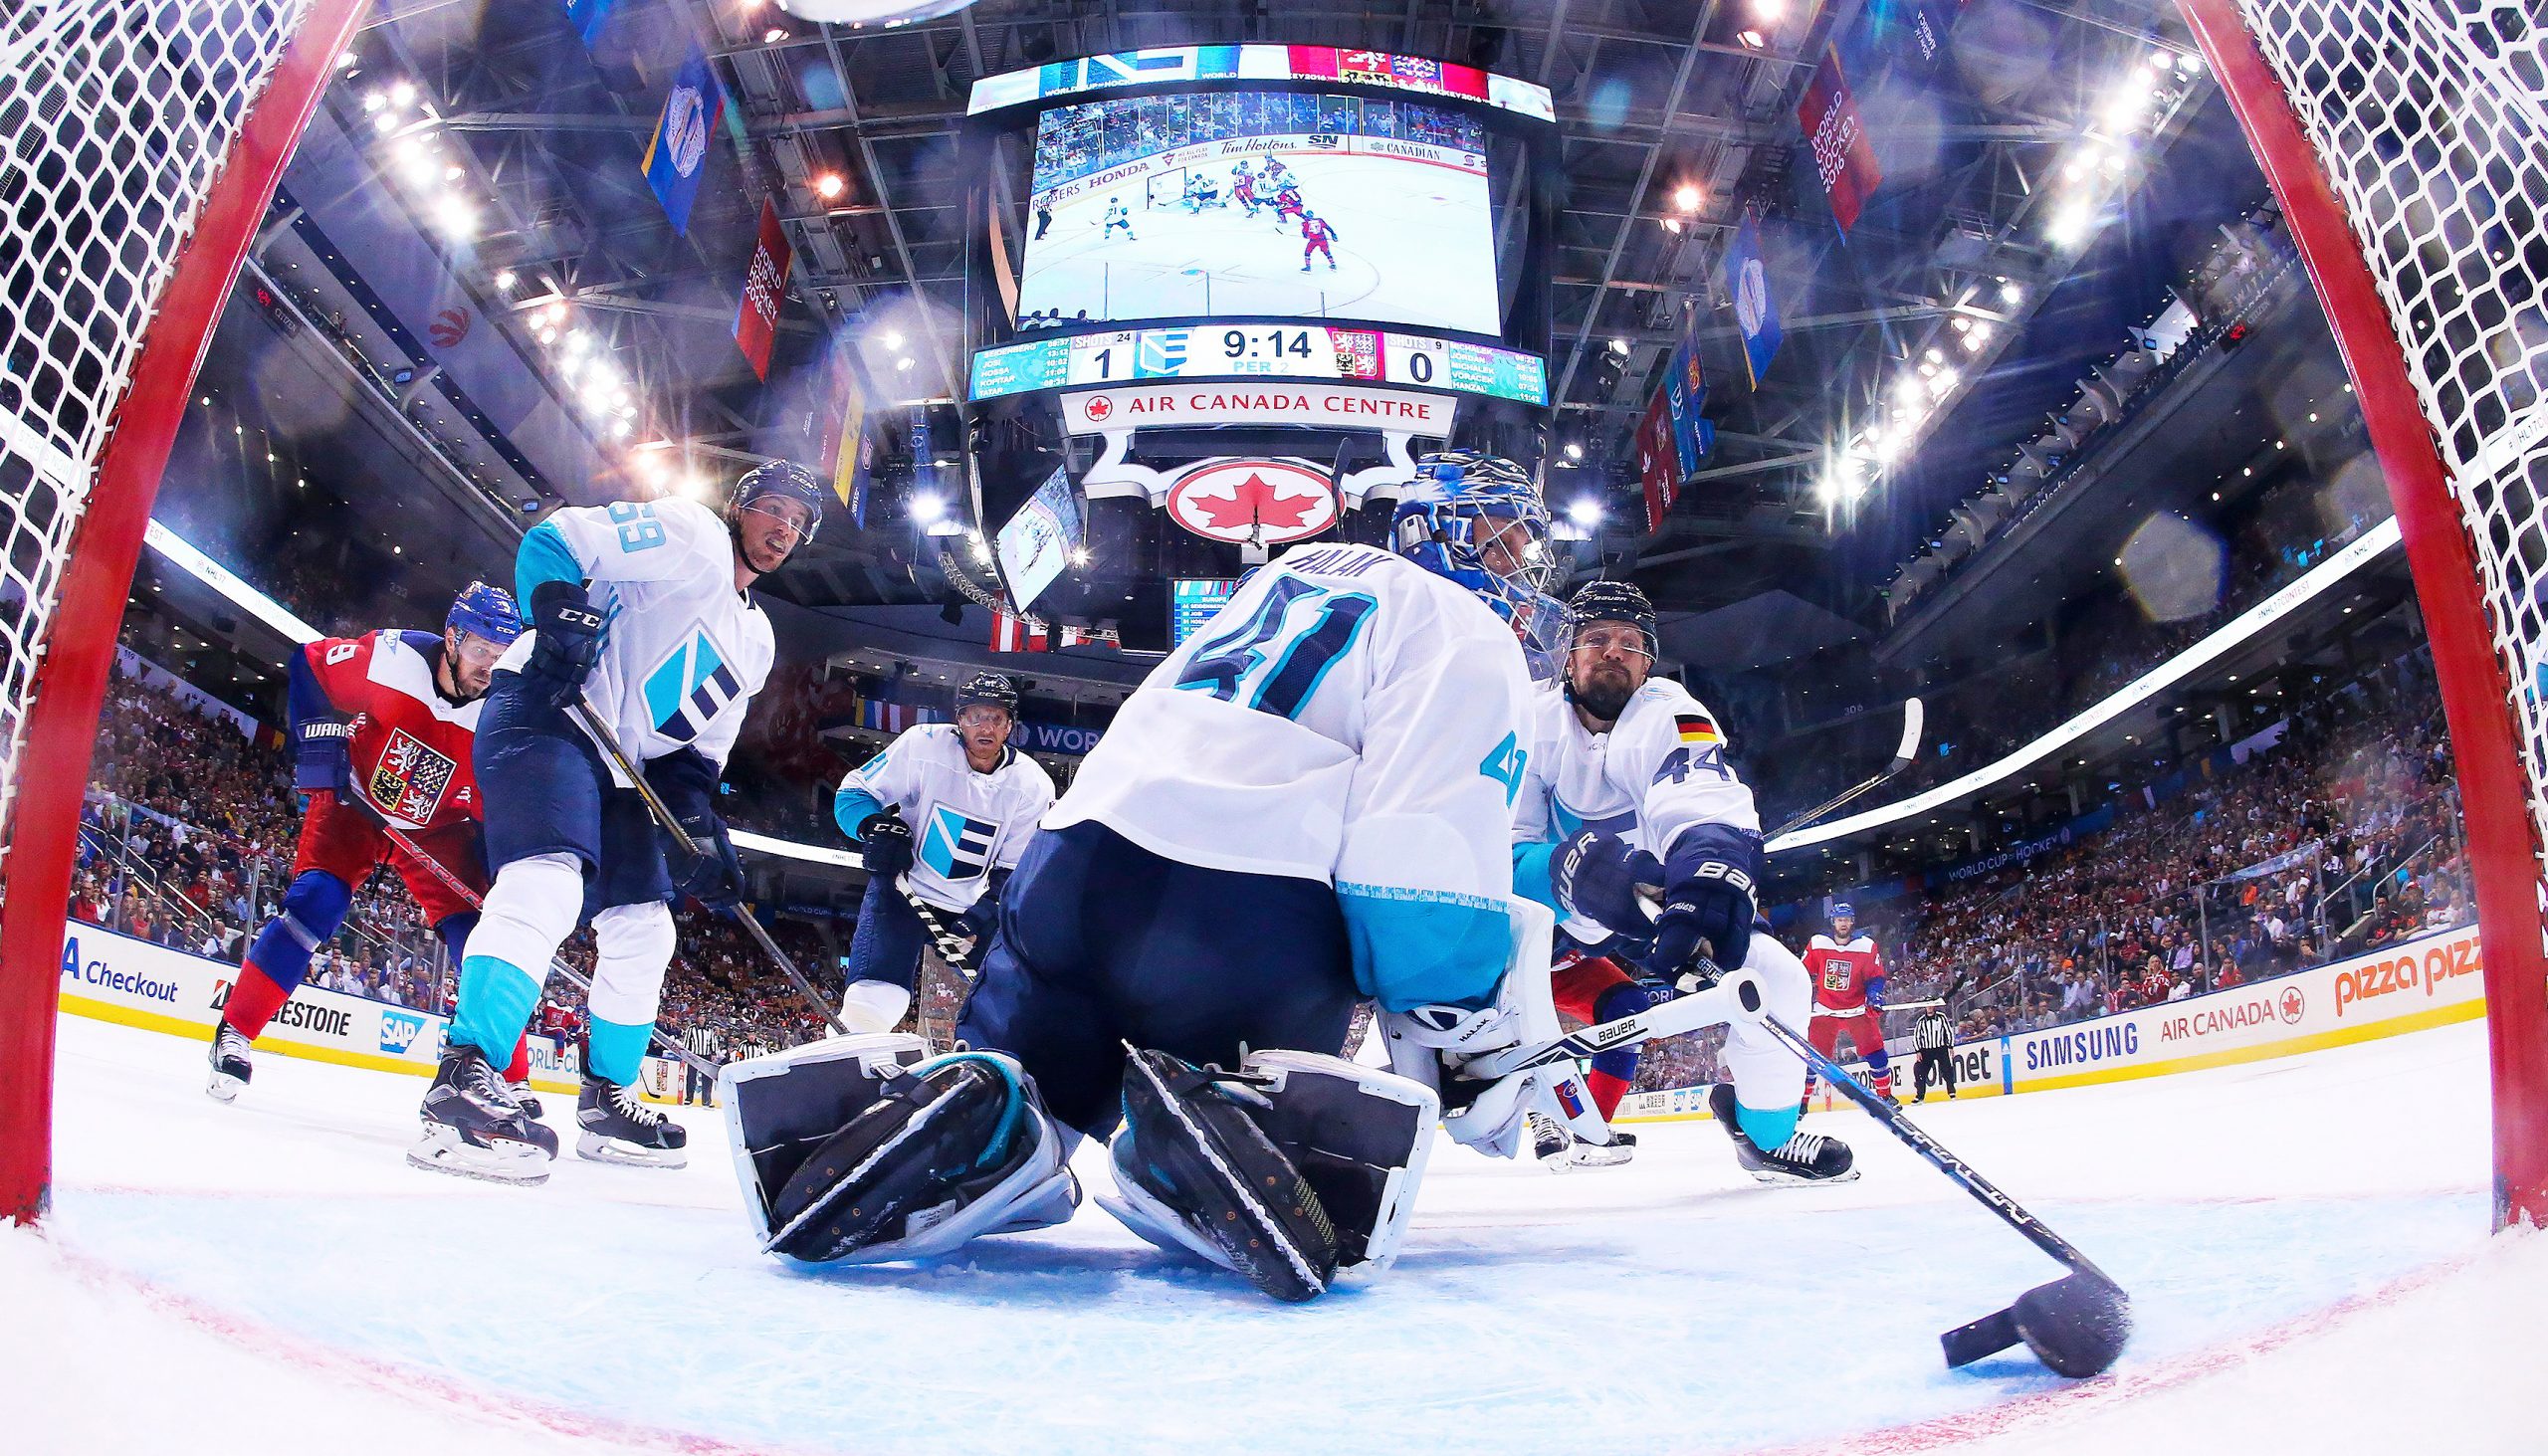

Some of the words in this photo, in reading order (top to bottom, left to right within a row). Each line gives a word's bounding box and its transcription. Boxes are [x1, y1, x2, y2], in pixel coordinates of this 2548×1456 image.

[1810, 91, 1842, 150] WORLD
[1221, 139, 1243, 155] Tim
[1308, 134, 1339, 147] SN
[1386, 141, 1441, 160] CANADIAN
[1815, 128, 1832, 165] CUP
[1818, 114, 1855, 180] HOCKEY
[1088, 162, 1151, 189] HONDA
[1823, 154, 1845, 194] 2016
[753, 253, 769, 282] CUP
[757, 238, 781, 290] WORLD
[745, 279, 763, 315] 2016
[749, 265, 777, 320] HOCKEY
[983, 343, 1038, 358] SEIDENBERG
[1074, 334, 1113, 348] SHOTS
[1116, 332, 1131, 343] 24
[1223, 329, 1313, 359] 9:14
[1388, 334, 1427, 349] SHOTS
[1434, 340, 1442, 350] 9
[1450, 342, 1494, 355] MICHALEK
[982, 358, 1002, 369] JOSI
[1094, 348, 1111, 379] 1
[1233, 360, 1271, 373] PER
[1279, 361, 1289, 373] 2
[1409, 351, 1433, 383] 0
[1450, 352, 1486, 364] JORDAN
[1451, 361, 1495, 374] MICHALEK
[978, 375, 1016, 388] KOPITAR
[980, 367, 1010, 378] HOSSA
[1451, 371, 1495, 384] VORACEK
[978, 387, 1004, 398] TATAR
[1452, 381, 1487, 393] HANZAL
[1129, 395, 1175, 414] AIR
[1189, 393, 1310, 413] CANADA
[1323, 395, 1431, 420] CENTRE
[789, 475, 814, 490] CCM
[149, 523, 163, 542] EST
[2353, 536, 2376, 557] NHL17
[204, 564, 227, 584] NHL17
[1285, 548, 1395, 577] HALAK
[2256, 579, 2311, 620] #NHL17CONTEST
[496, 625, 517, 636] CCM
[1171, 571, 1380, 723] 41
[977, 690, 1000, 699] CCM
[1652, 742, 1732, 787] 44
[1948, 860, 1987, 884] WORLD
[1987, 852, 2009, 872] CUP
[2016, 834, 2058, 861] HOCKEY
[86, 959, 179, 1003] Checkout
[2334, 955, 2418, 1017] pizza
[381, 1017, 417, 1048] SAP
[1458, 1017, 1491, 1043] HALAK
[2161, 1017, 2191, 1044] AIR
[2193, 998, 2276, 1036] CANADA
[528, 1046, 560, 1072] ORLD
[2026, 1021, 2139, 1072] SAMSUNG
